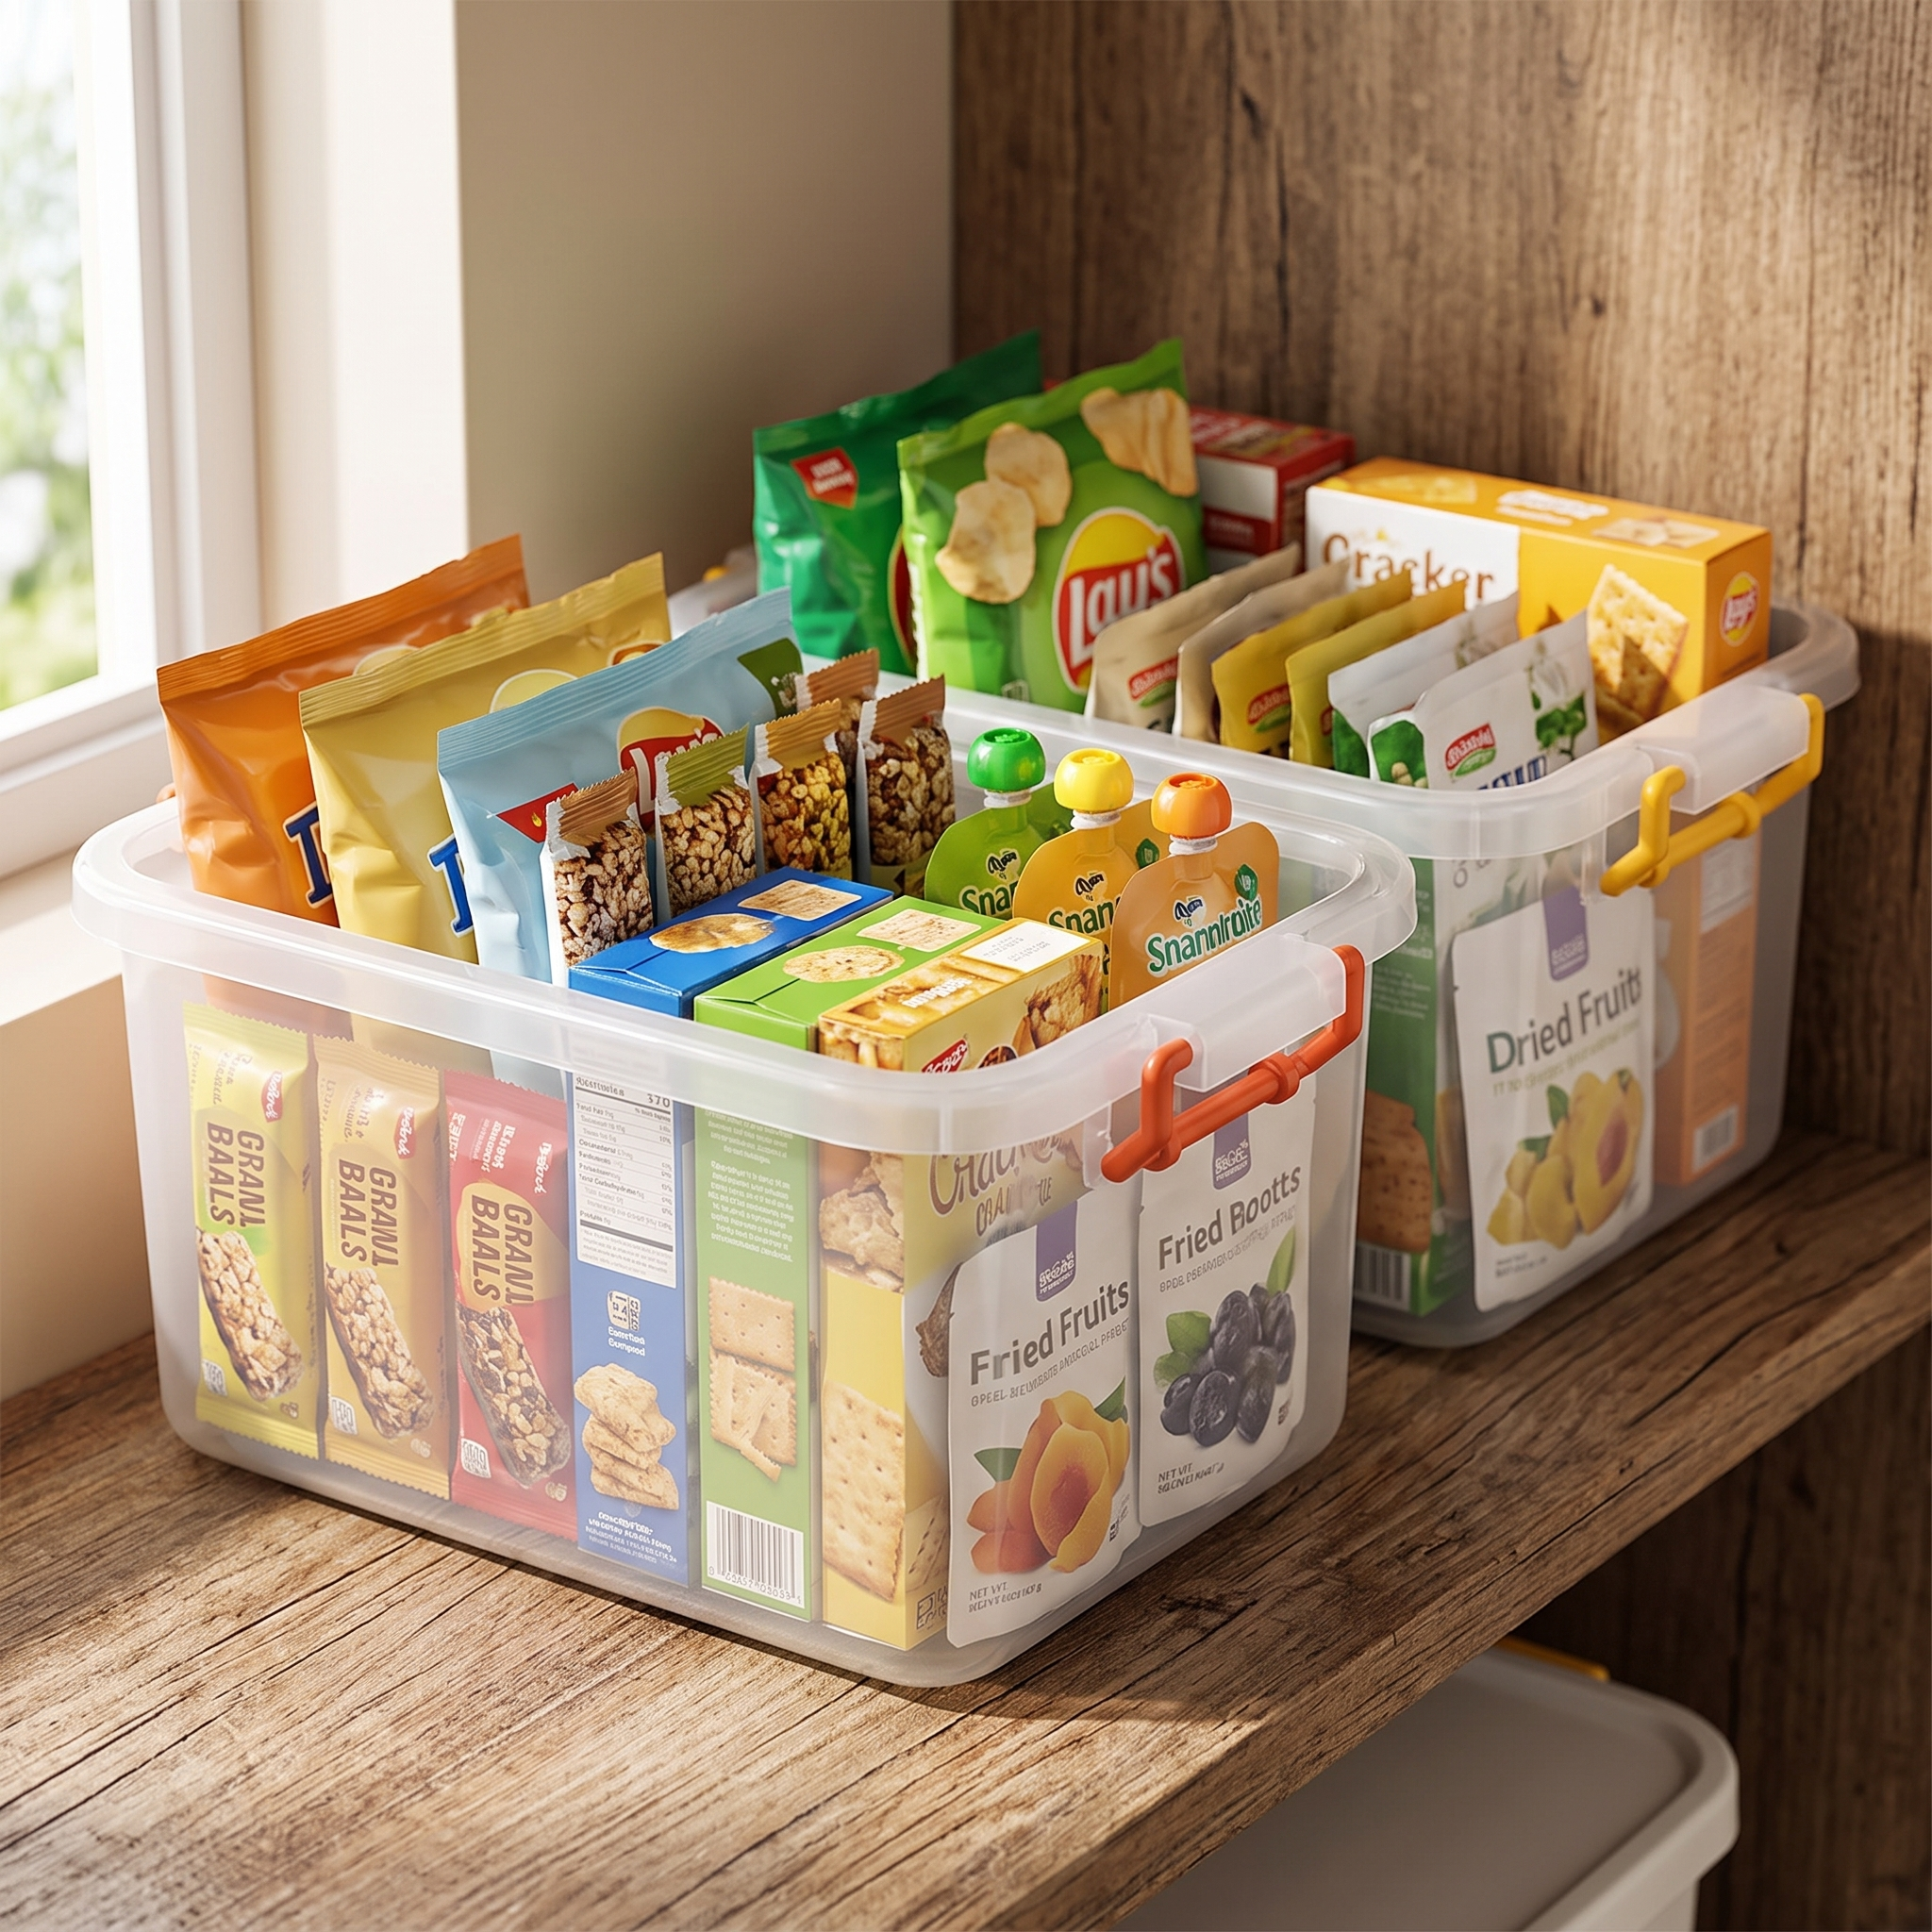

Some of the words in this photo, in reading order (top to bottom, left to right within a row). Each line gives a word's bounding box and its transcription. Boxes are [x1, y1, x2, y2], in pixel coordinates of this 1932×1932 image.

[1487, 1006, 1572, 1074] Dried
[207, 1122, 235, 1226] BAALS
[339, 1159, 367, 1262] BAALS
[472, 1195, 501, 1301] BAALS
[1158, 1214, 1224, 1271] Fried
[970, 1329, 1055, 1386] Fried
[1059, 1279, 1129, 1348] Fruits
